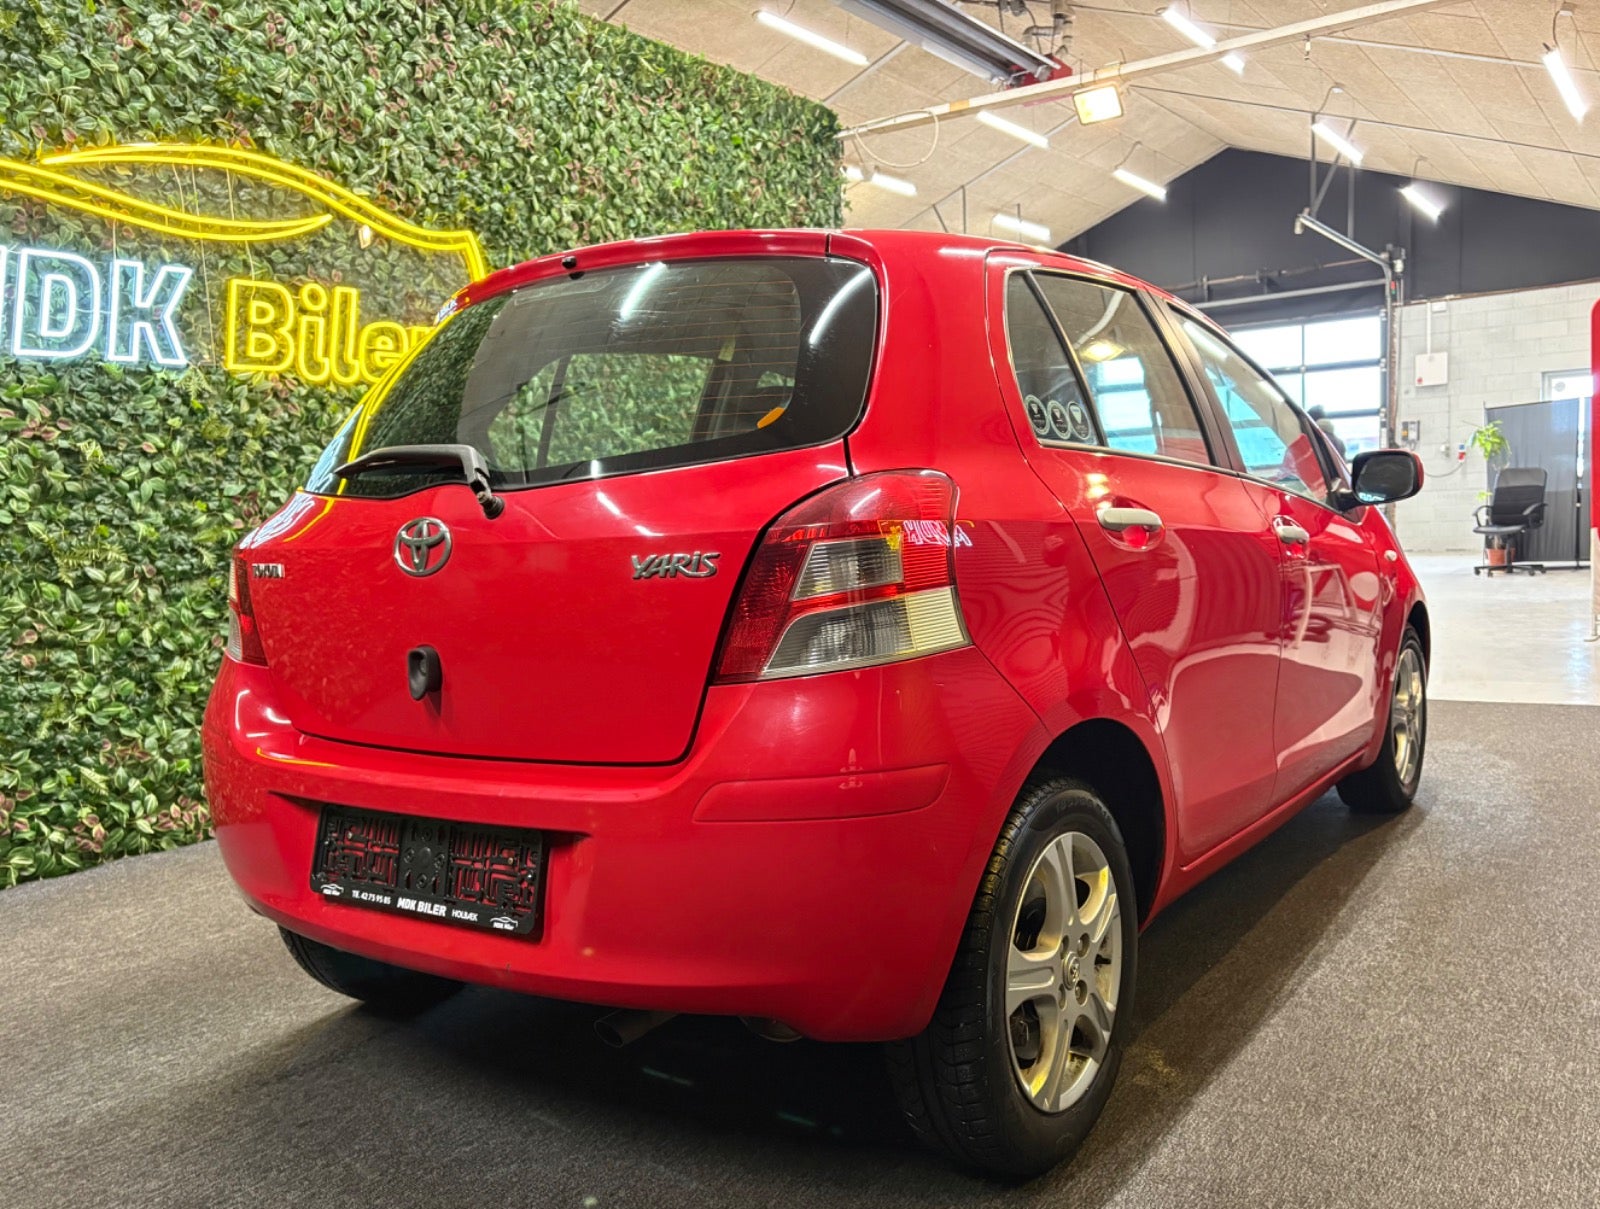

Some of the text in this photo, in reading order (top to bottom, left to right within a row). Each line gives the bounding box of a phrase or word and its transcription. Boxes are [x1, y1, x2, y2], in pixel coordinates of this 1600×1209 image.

[0, 246, 193, 367] DK
[397, 897, 417, 911] MDK
[417, 900, 447, 917] BILER
